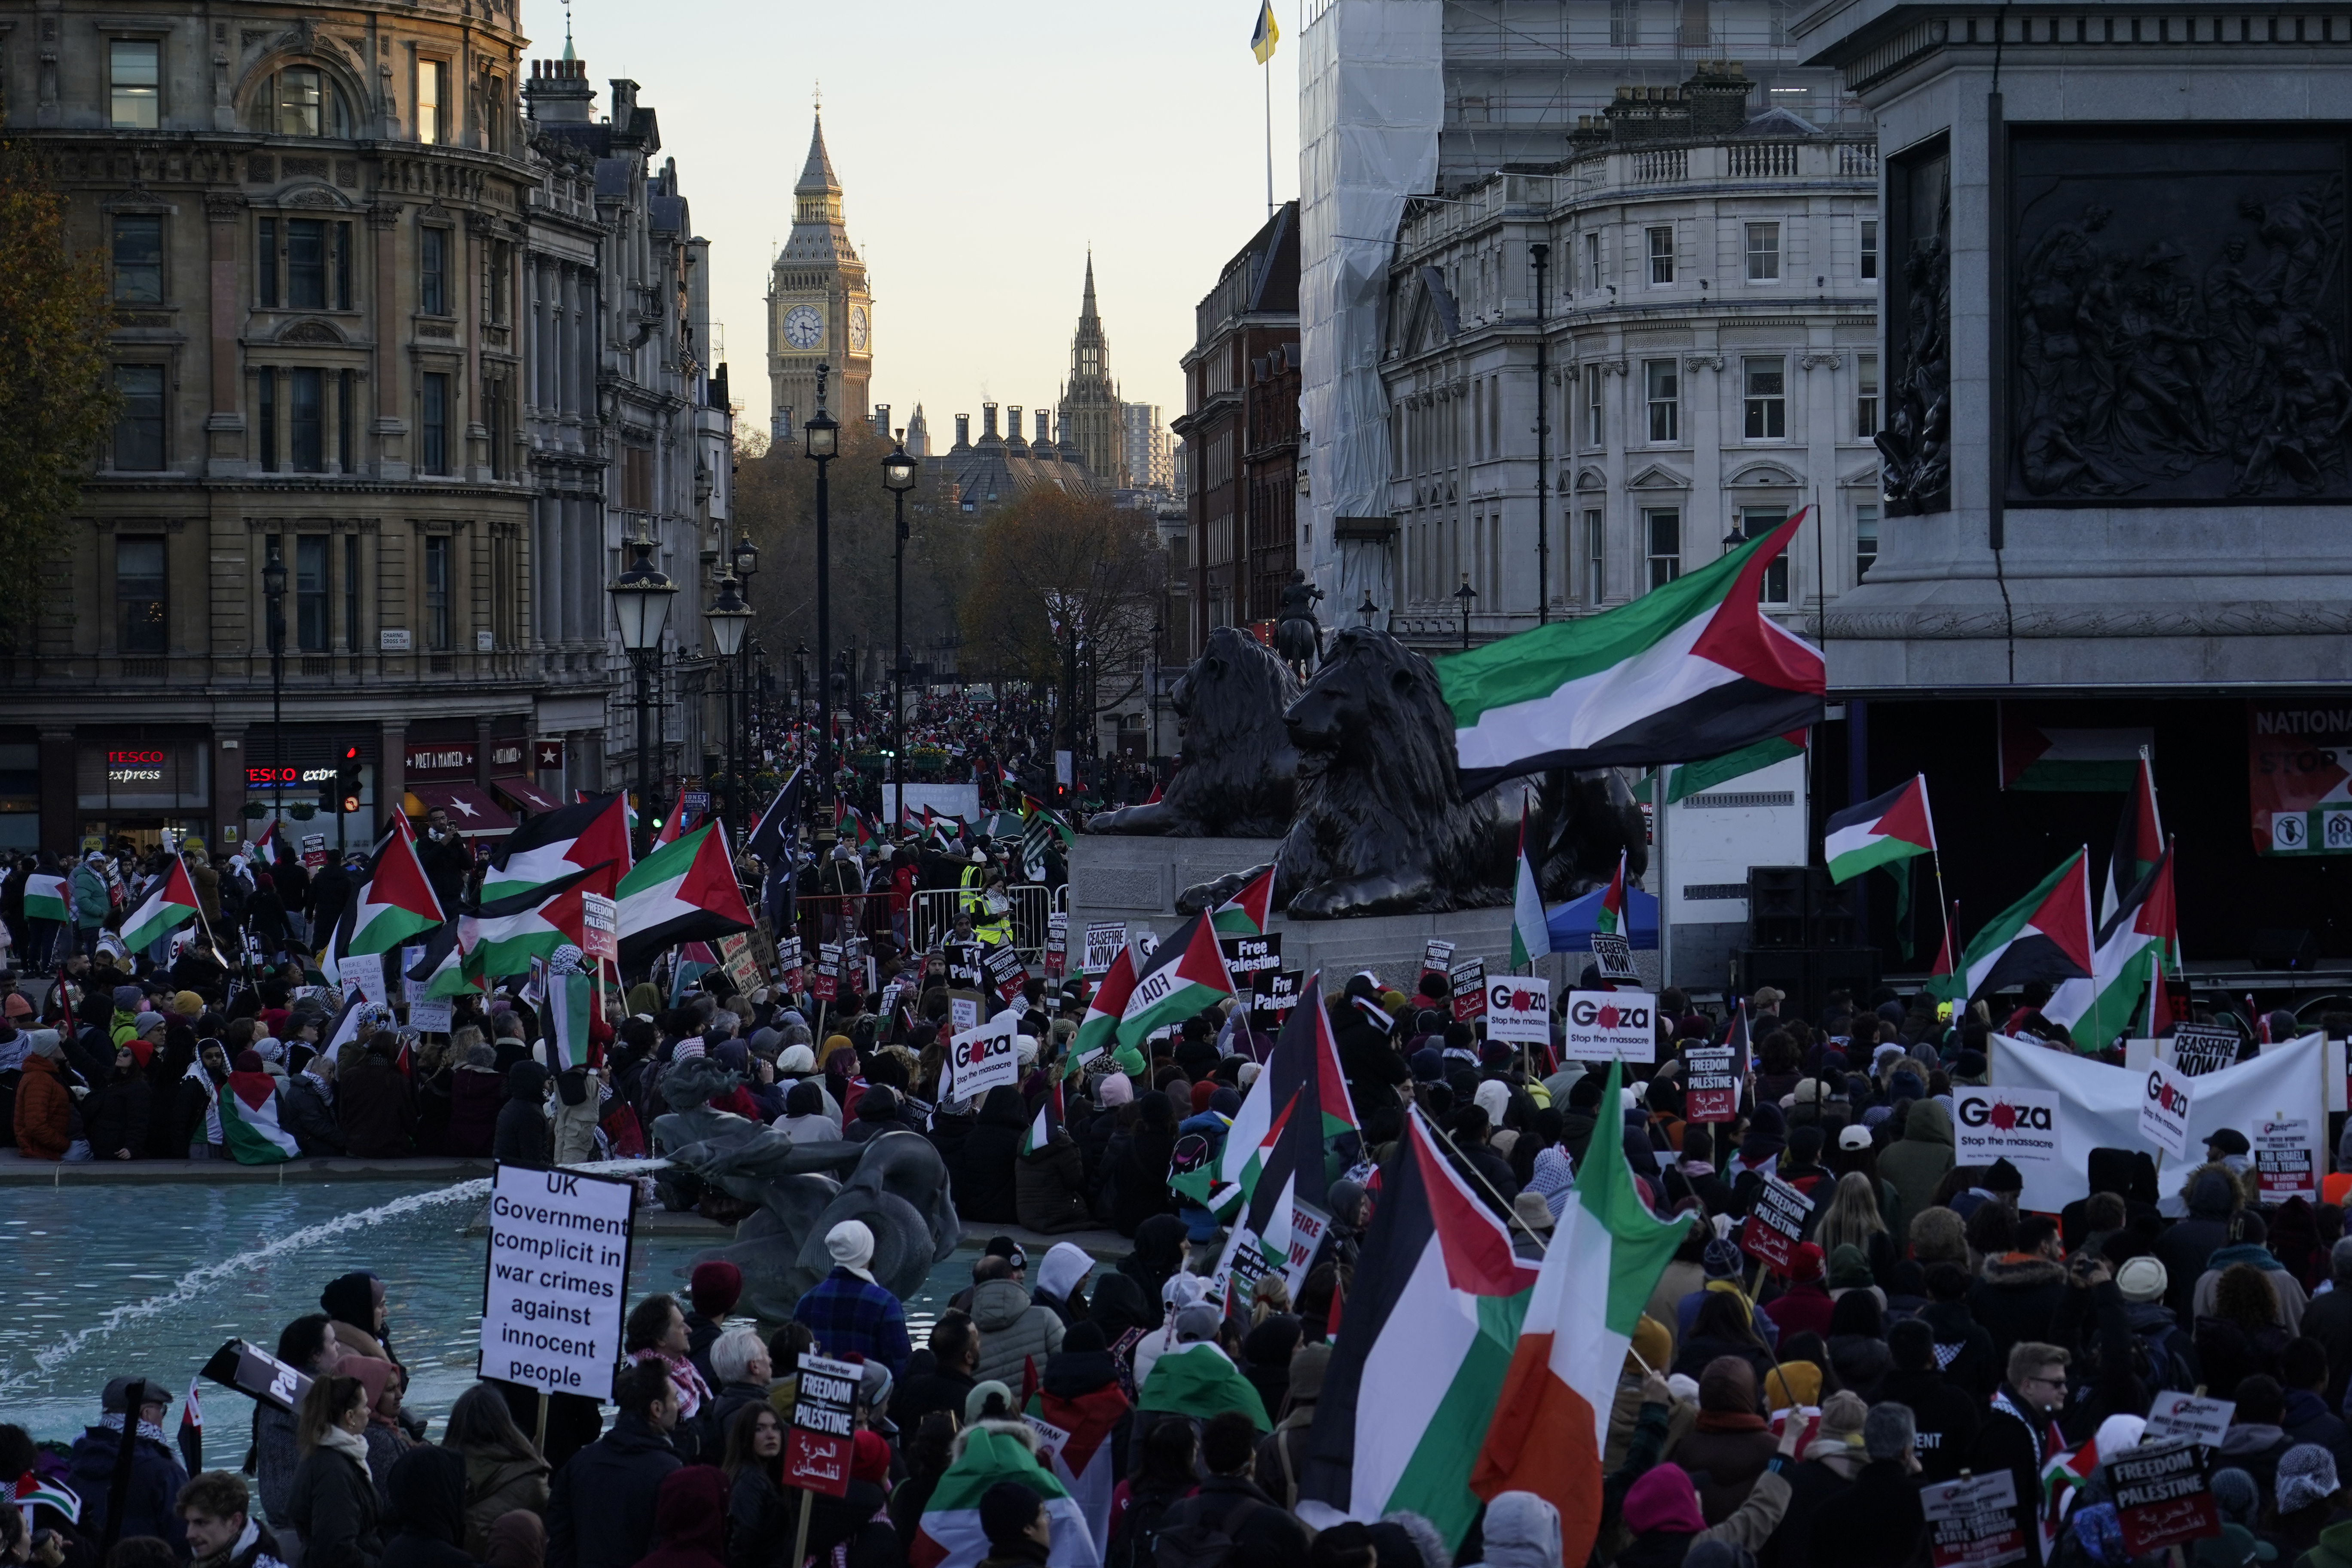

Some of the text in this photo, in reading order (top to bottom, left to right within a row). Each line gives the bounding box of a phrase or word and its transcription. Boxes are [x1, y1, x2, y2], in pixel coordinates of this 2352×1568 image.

[105, 751, 163, 763] TESCO
[415, 752, 463, 769] PRET A MANGER
[2260, 750, 2337, 773] STOP
[107, 769, 161, 783] express
[586, 901, 614, 919] FREEDOM
[584, 915, 615, 934] PALESTINE
[1049, 929, 1065, 939] FREEDOM
[1048, 942, 1065, 952] PALESTINE
[1087, 929, 1124, 946] CEASEFIRE
[820, 951, 839, 963] FREEDOM
[1238, 941, 1268, 956] Free
[1427, 948, 1450, 959] FREEDOM
[1594, 941, 1631, 957] CEASEFIRE
[818, 965, 838, 977] PALESTINE
[990, 952, 1016, 973] FREEDOM
[1224, 954, 1280, 973] Palestine
[1423, 959, 1449, 971] PALESTINE
[995, 962, 1024, 985] PALESTINE
[1454, 966, 1481, 984] FREEDOM
[1272, 976, 1292, 993] Free
[1454, 978, 1484, 998] PALESTINE
[1254, 992, 1298, 1010] Palestine
[1460, 993, 1479, 1006] الحرية
[1491, 985, 1546, 1012] Gza
[1491, 1016, 1508, 1026] Stop
[1572, 1000, 1648, 1029] Gza
[1571, 1034, 1591, 1044] Stop
[1593, 1035, 1607, 1043] the
[2175, 1034, 2236, 1057] CEASEFIRE
[956, 1034, 1010, 1068] Gza
[956, 1061, 1011, 1085] Stop the massacre
[1689, 1058, 1730, 1072] FREEDOM
[1688, 1075, 1732, 1090] PALESTINE
[1695, 1093, 1725, 1106] الحرية
[2148, 1070, 2188, 1120] Gza
[1692, 1104, 1729, 1117] لفلسطين
[1959, 1097, 2052, 1131] Gza
[2144, 1106, 2154, 1119] Stop
[2154, 1112, 2163, 1125] the
[1961, 1136, 2053, 1149] Stop the massacre
[2260, 1150, 2305, 1162] END ISRAELI
[2258, 1161, 2310, 1172] STATE TERROR
[547, 1173, 579, 1197] UK
[1762, 1185, 1806, 1223] FREEDOM
[494, 1196, 628, 1237] Government
[1754, 1202, 1802, 1242] PALESTINE
[495, 1232, 620, 1267] complicit in
[1237, 1247, 1266, 1268] end the
[1242, 1265, 1252, 1274] of
[495, 1263, 614, 1298] war crimes
[1239, 1280, 1252, 1291] End
[512, 1299, 591, 1325] against
[502, 1323, 595, 1358] innocent
[510, 1361, 581, 1387] people
[828, 1364, 851, 1376] Worker
[801, 1373, 852, 1404] FREEDOM
[817, 1398, 827, 1409] for
[794, 1403, 852, 1437] PALESTINE
[1035, 1422, 1062, 1441] THAN
[800, 1435, 837, 1459] الحرية
[792, 1458, 840, 1481] لفلسطين
[2113, 1449, 2193, 1483] FREEDOM
[2116, 1472, 2205, 1509] PALESTINE
